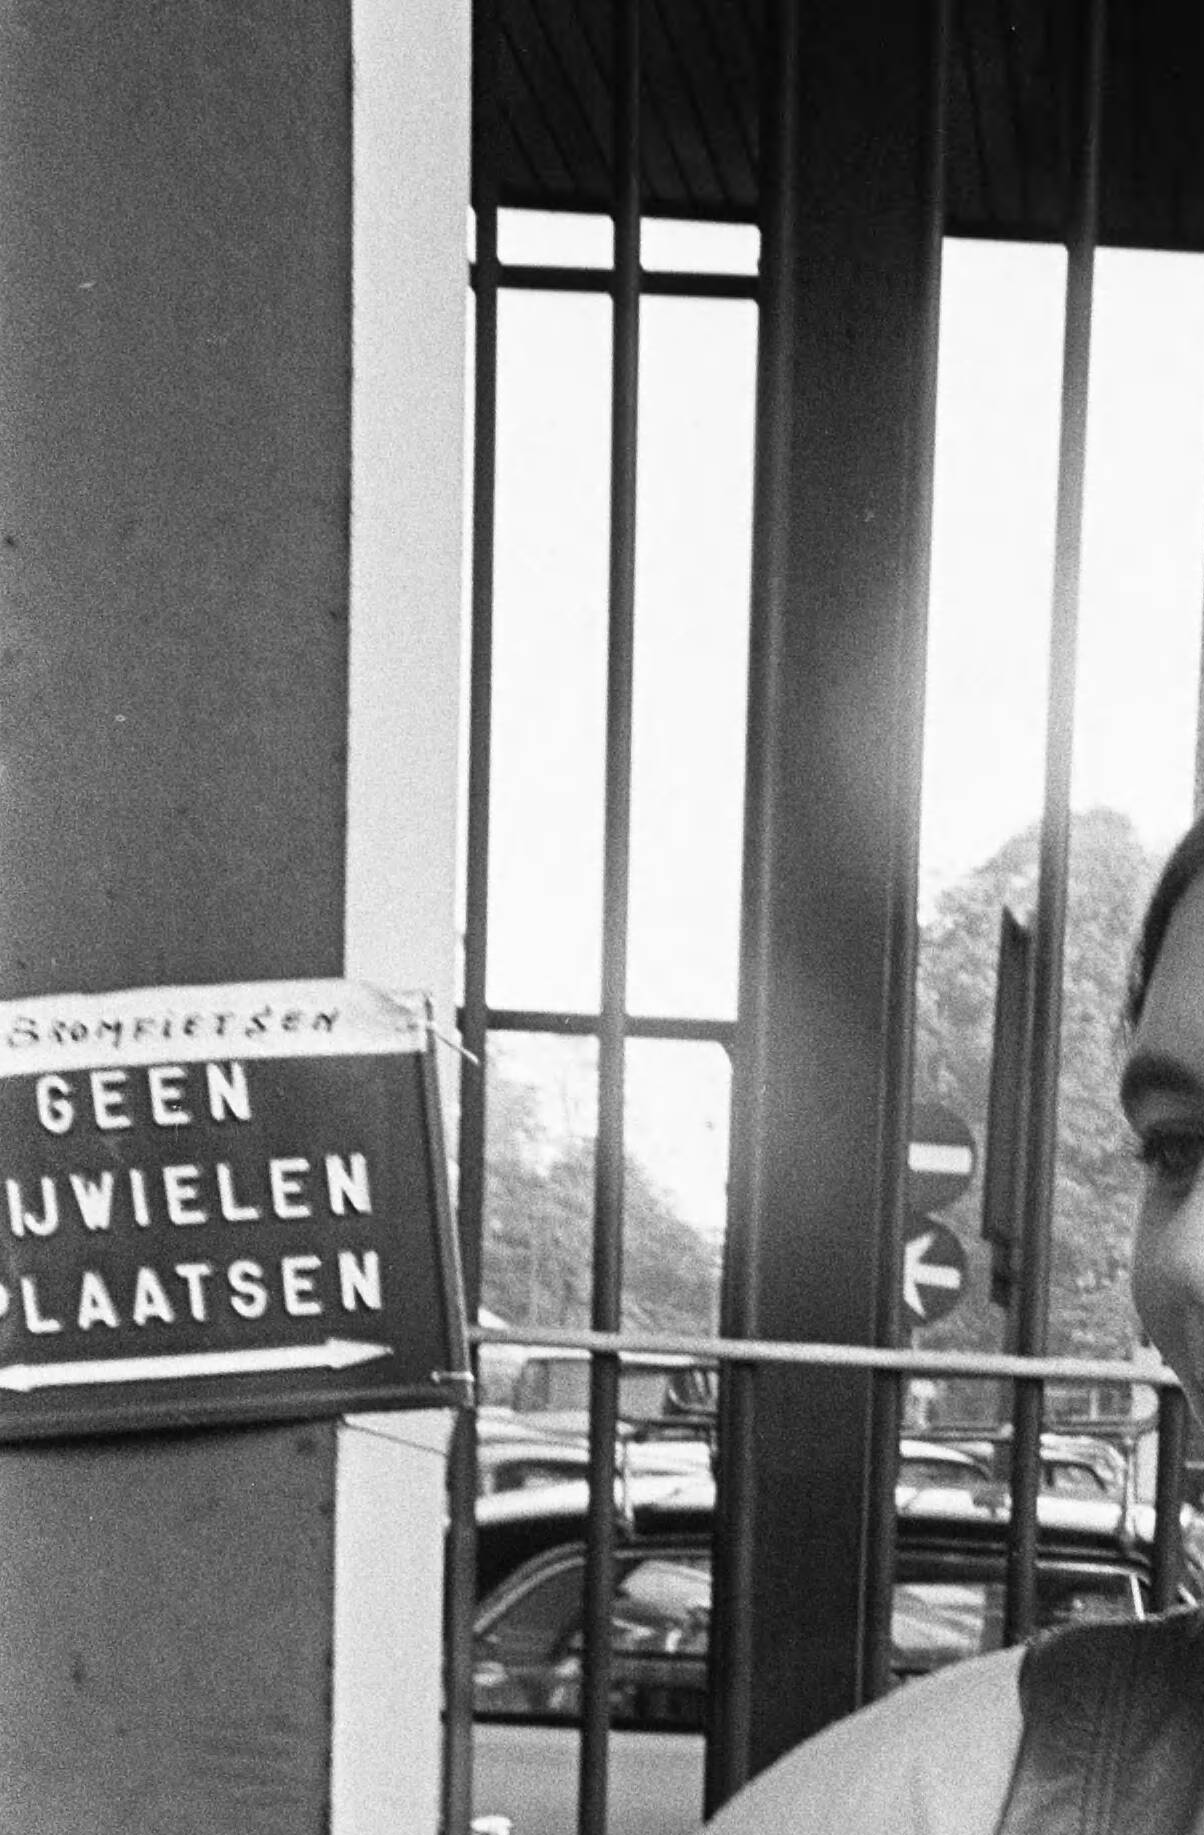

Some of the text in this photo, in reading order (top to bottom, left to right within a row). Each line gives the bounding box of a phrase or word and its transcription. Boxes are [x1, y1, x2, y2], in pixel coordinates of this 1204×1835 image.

[35, 1060, 252, 1134] GEEN
[0, 1152, 373, 1237] IJWIELEN
[0, 1250, 383, 1334] LAATSEN
